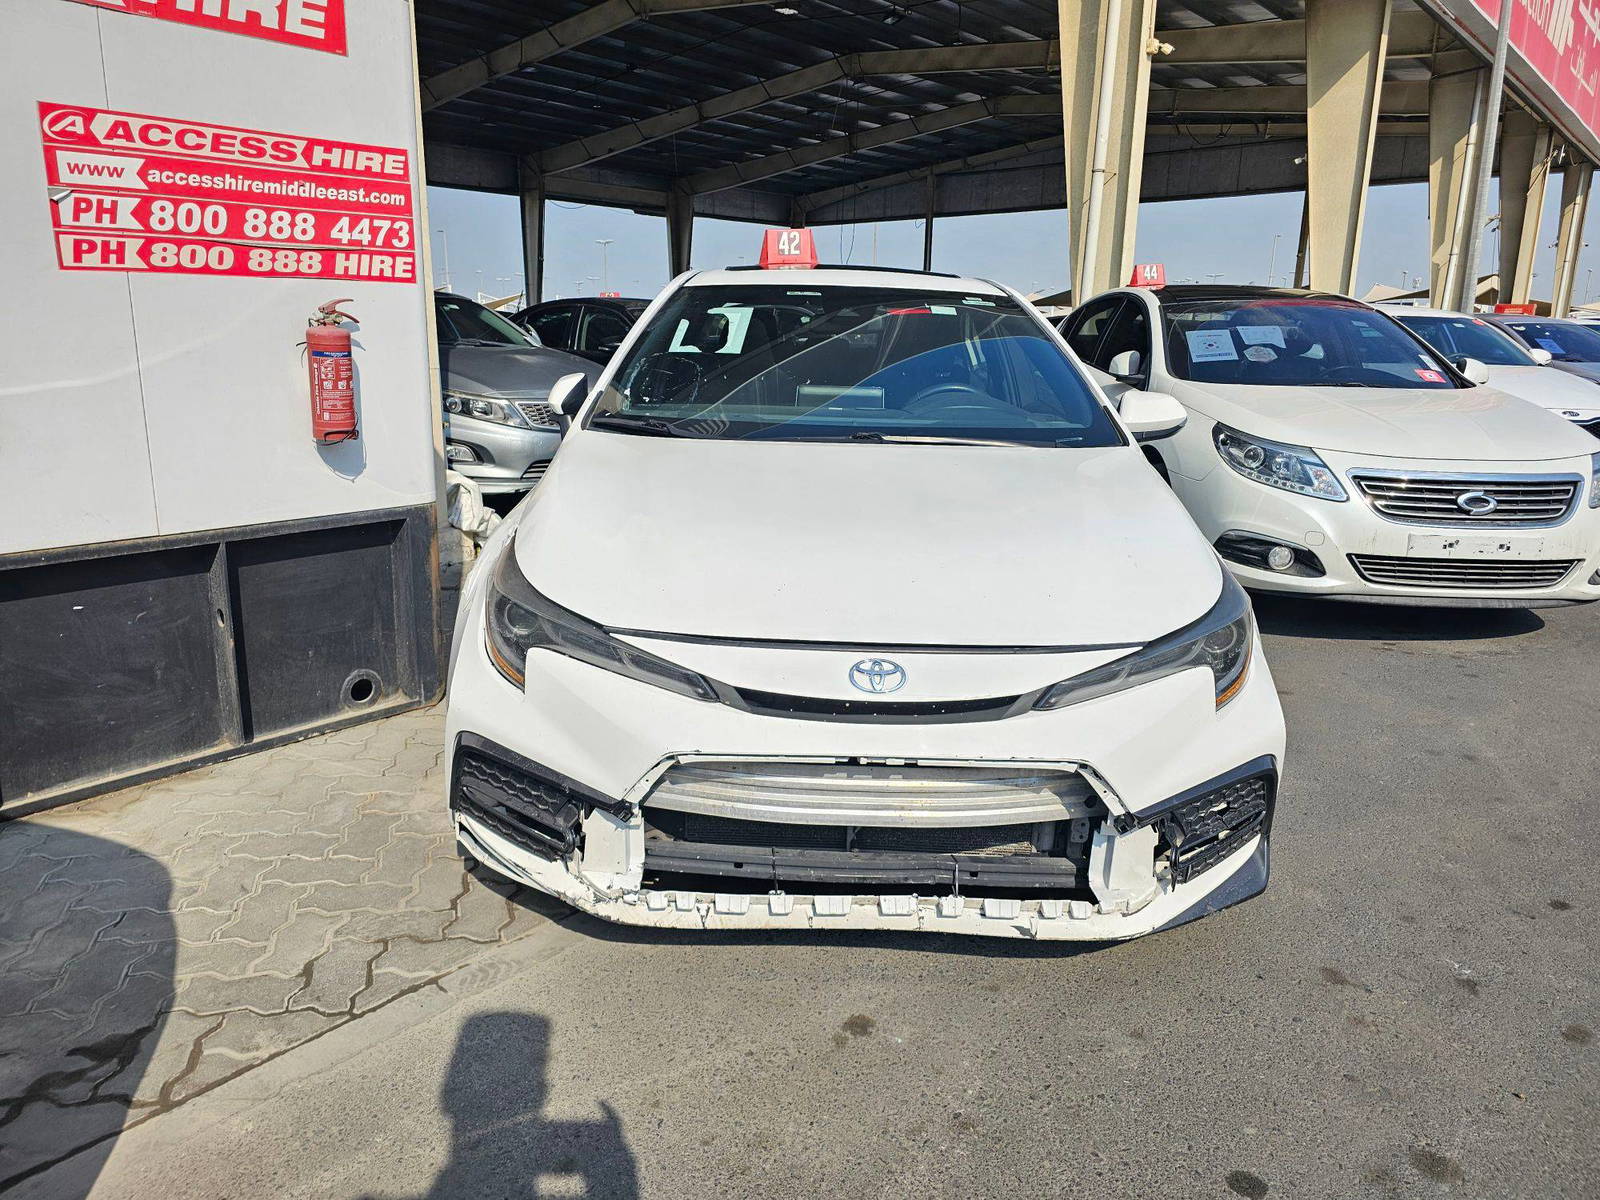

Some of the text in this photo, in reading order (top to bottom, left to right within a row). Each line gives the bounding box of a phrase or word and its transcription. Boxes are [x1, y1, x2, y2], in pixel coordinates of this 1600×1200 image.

[103, 120, 298, 163] ACCESS
[311, 145, 406, 175] HIRE
[66, 162, 405, 206] www accesshiremiddleeast.com
[72, 196, 410, 248] PH 800 888 4473
[778, 231, 801, 255] 42
[72, 238, 413, 278] PH 800 888 HIRE
[1144, 264, 1158, 280] 44
